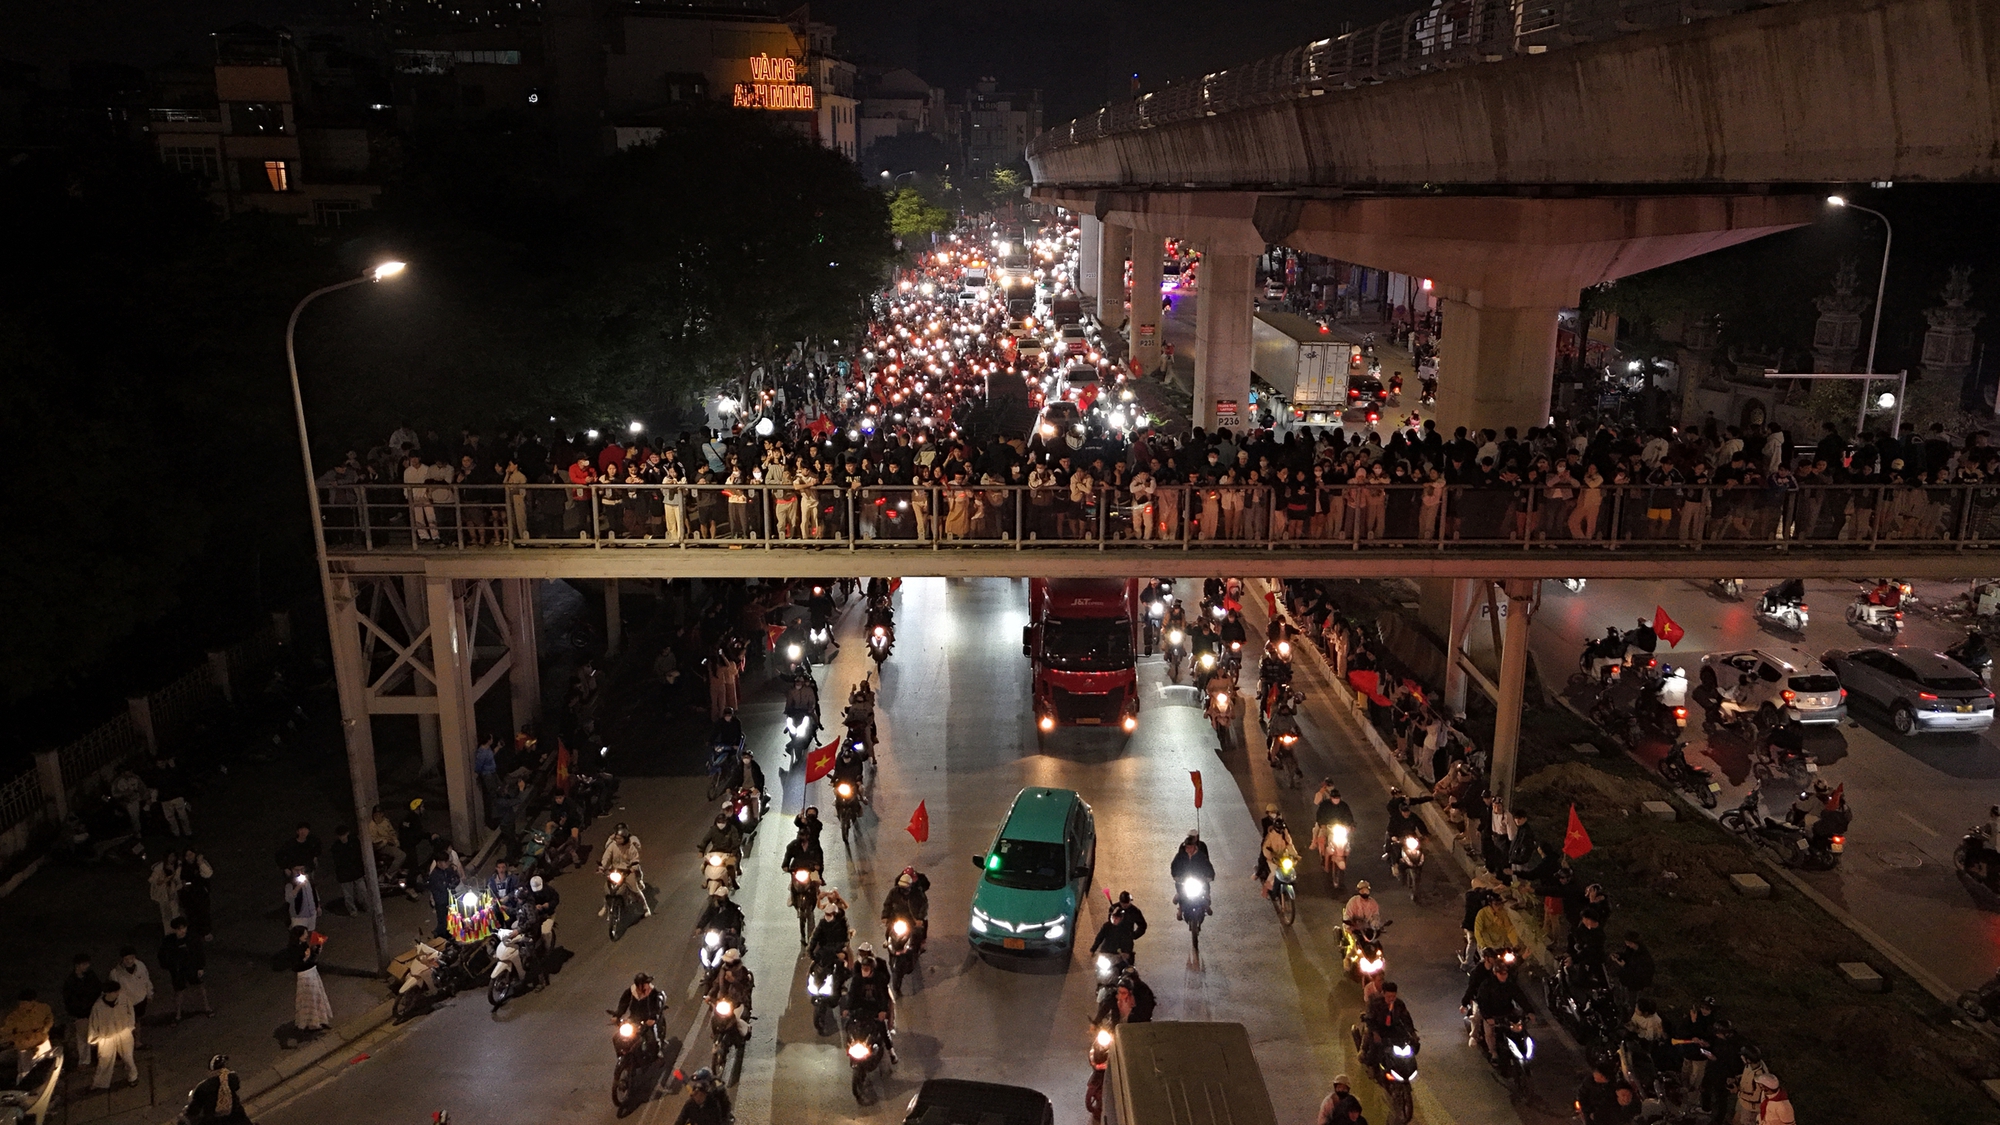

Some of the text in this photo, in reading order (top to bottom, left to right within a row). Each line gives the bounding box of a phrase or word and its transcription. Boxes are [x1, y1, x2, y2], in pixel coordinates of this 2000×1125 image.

[750, 52, 796, 81] VÀNG
[770, 84, 813, 109] MINH
[1218, 417, 1240, 426] P236
[1070, 598, 1092, 606] J&T
